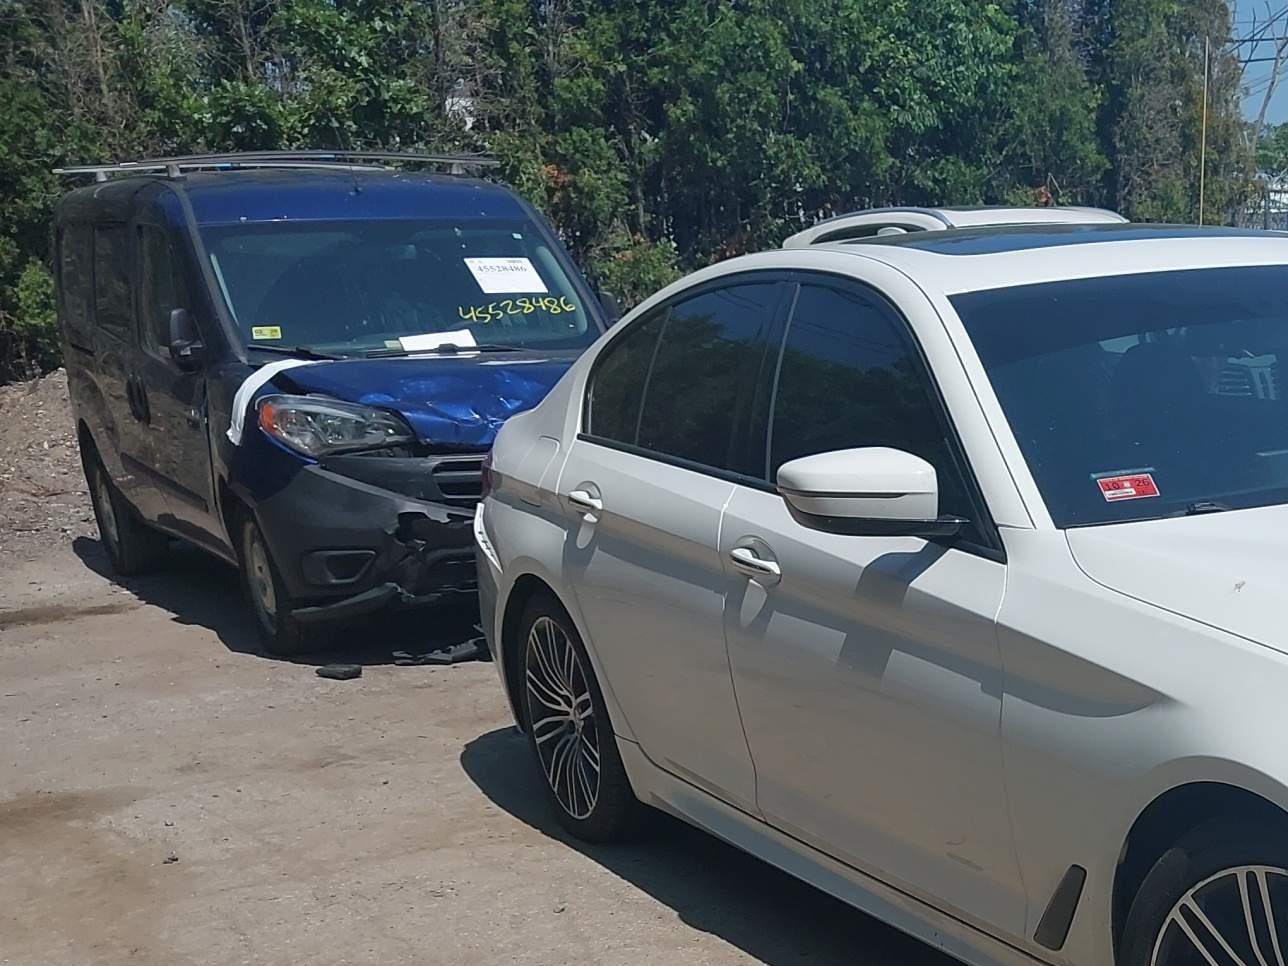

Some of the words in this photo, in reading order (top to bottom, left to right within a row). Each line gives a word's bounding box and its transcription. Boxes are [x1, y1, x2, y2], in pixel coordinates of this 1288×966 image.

[477, 265, 527, 273] 45528486
[458, 296, 576, 323] 45528486
[1134, 479, 1150, 487] 26
